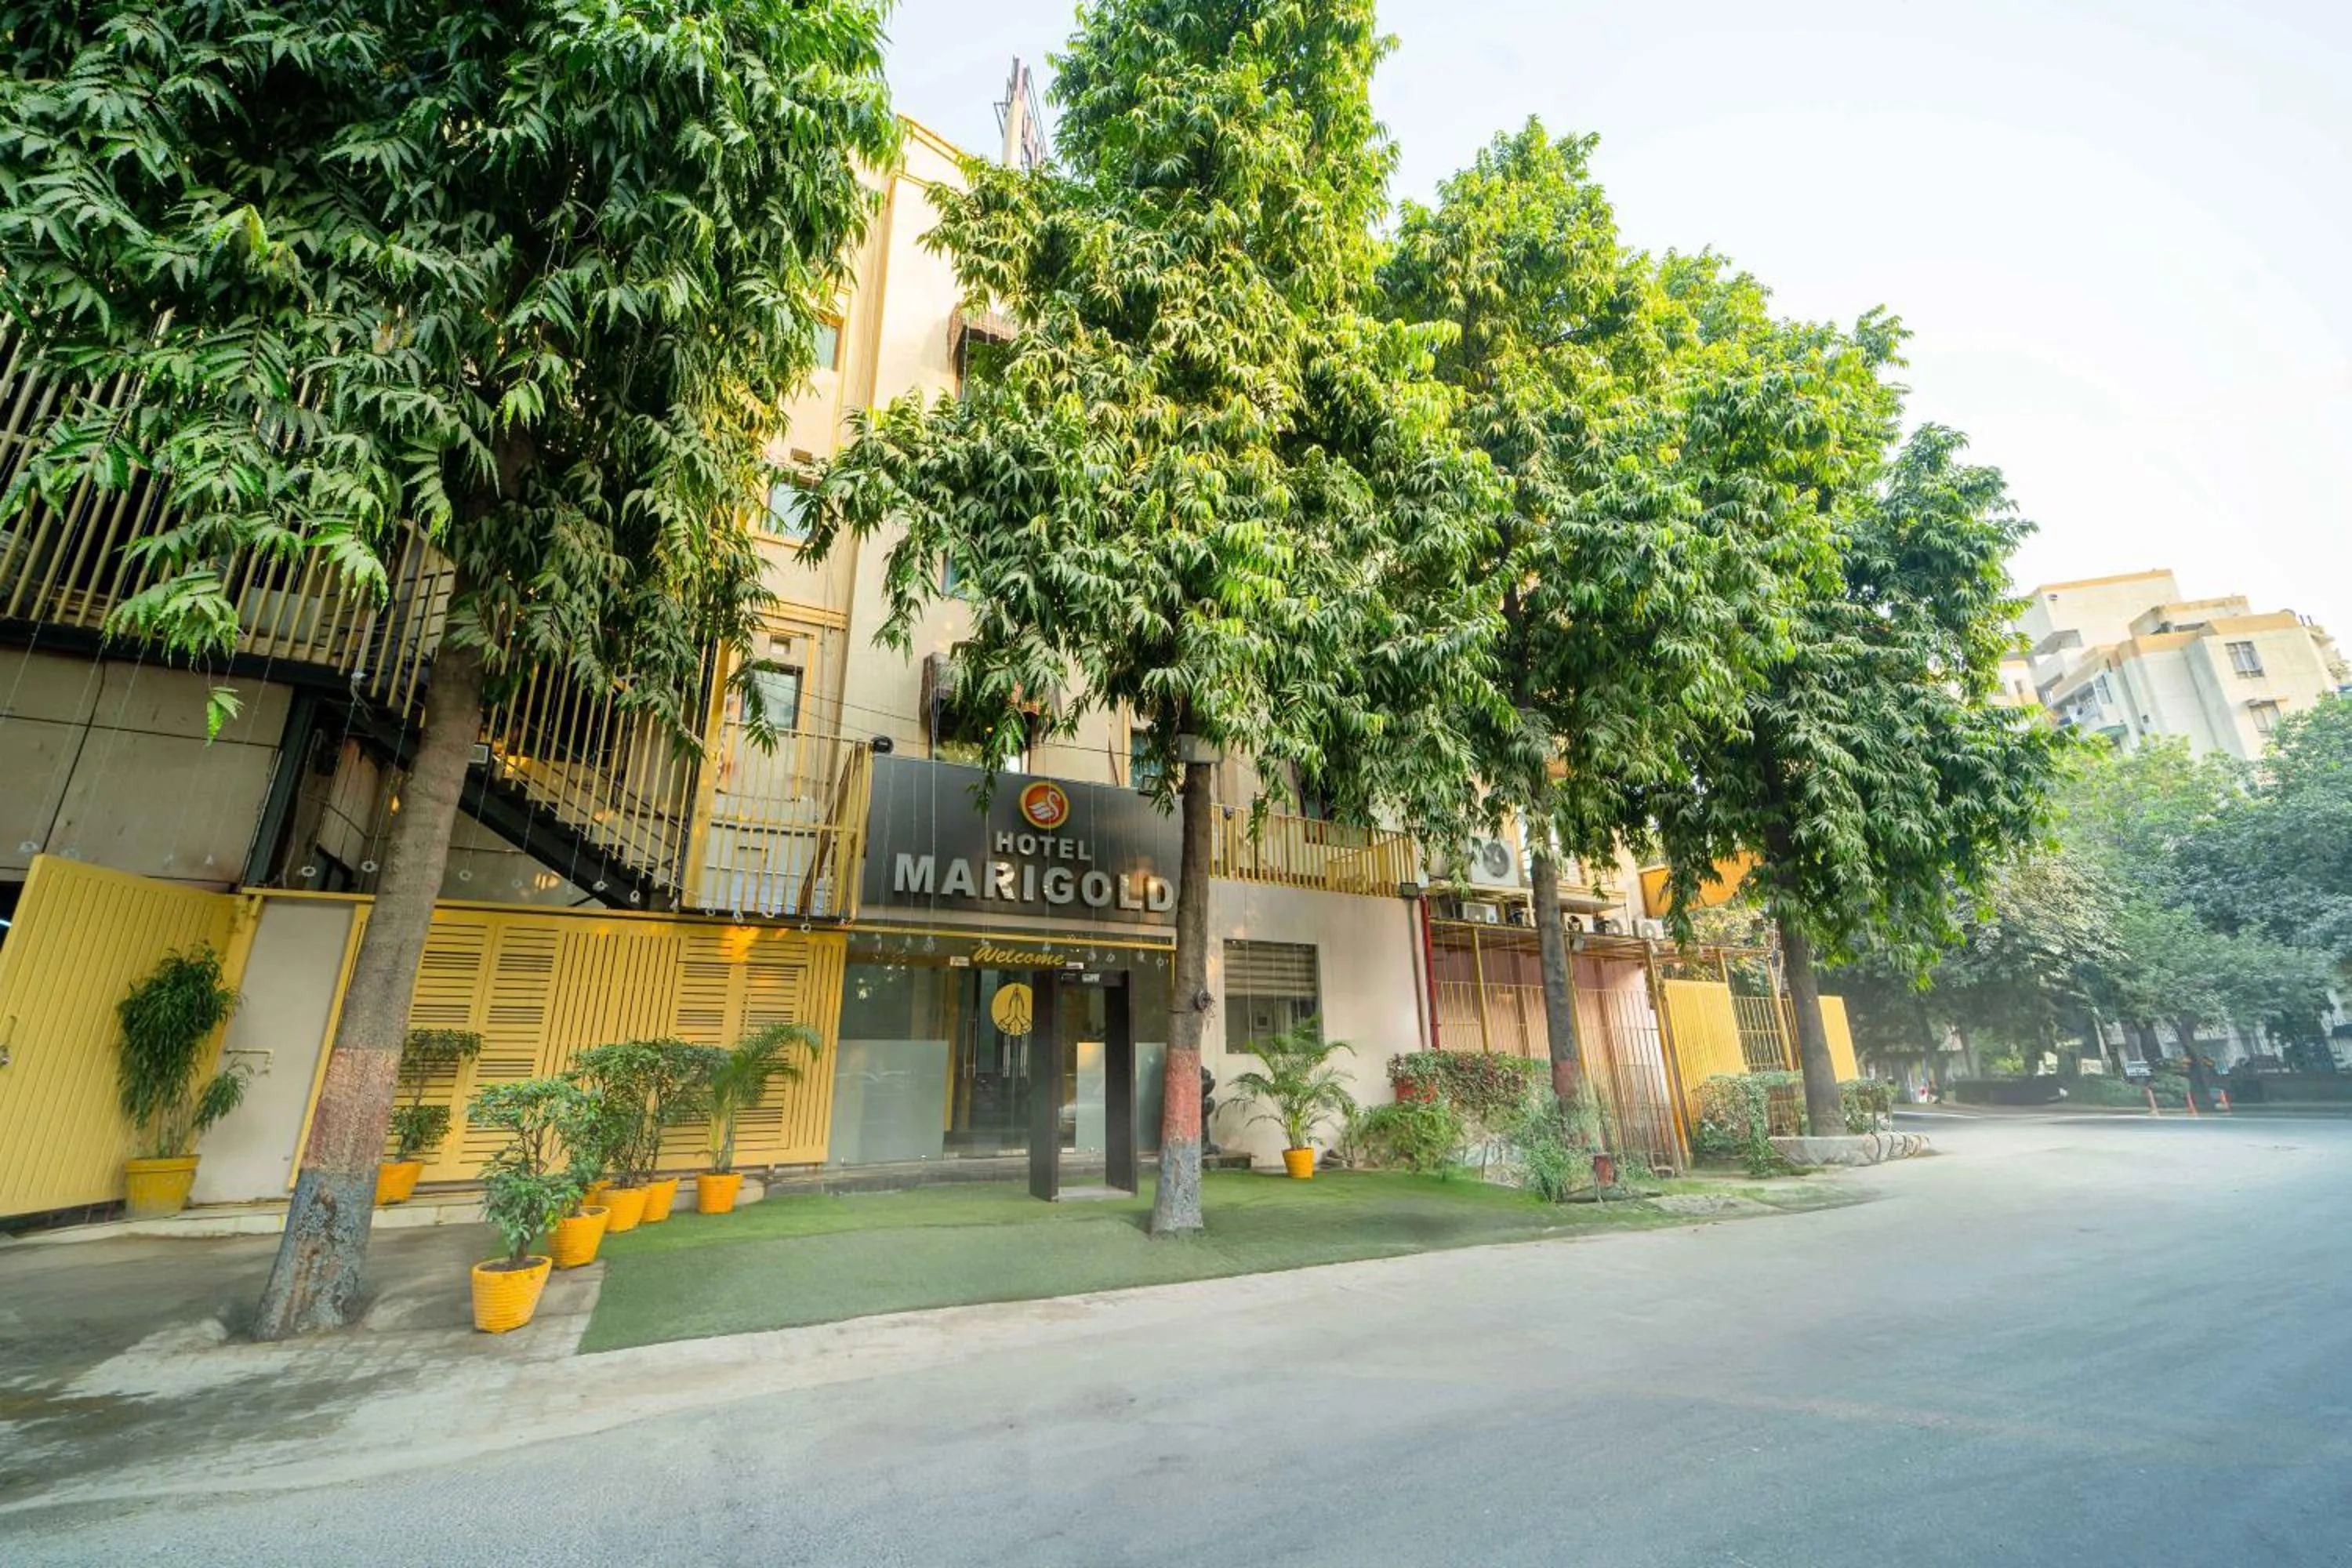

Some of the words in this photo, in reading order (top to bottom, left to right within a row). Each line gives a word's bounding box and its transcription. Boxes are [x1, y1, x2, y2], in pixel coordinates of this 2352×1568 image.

[995, 831, 1092, 861] HOTEL
[893, 853, 1174, 912] MARIGOLD
[971, 945, 1065, 966] Welcome
